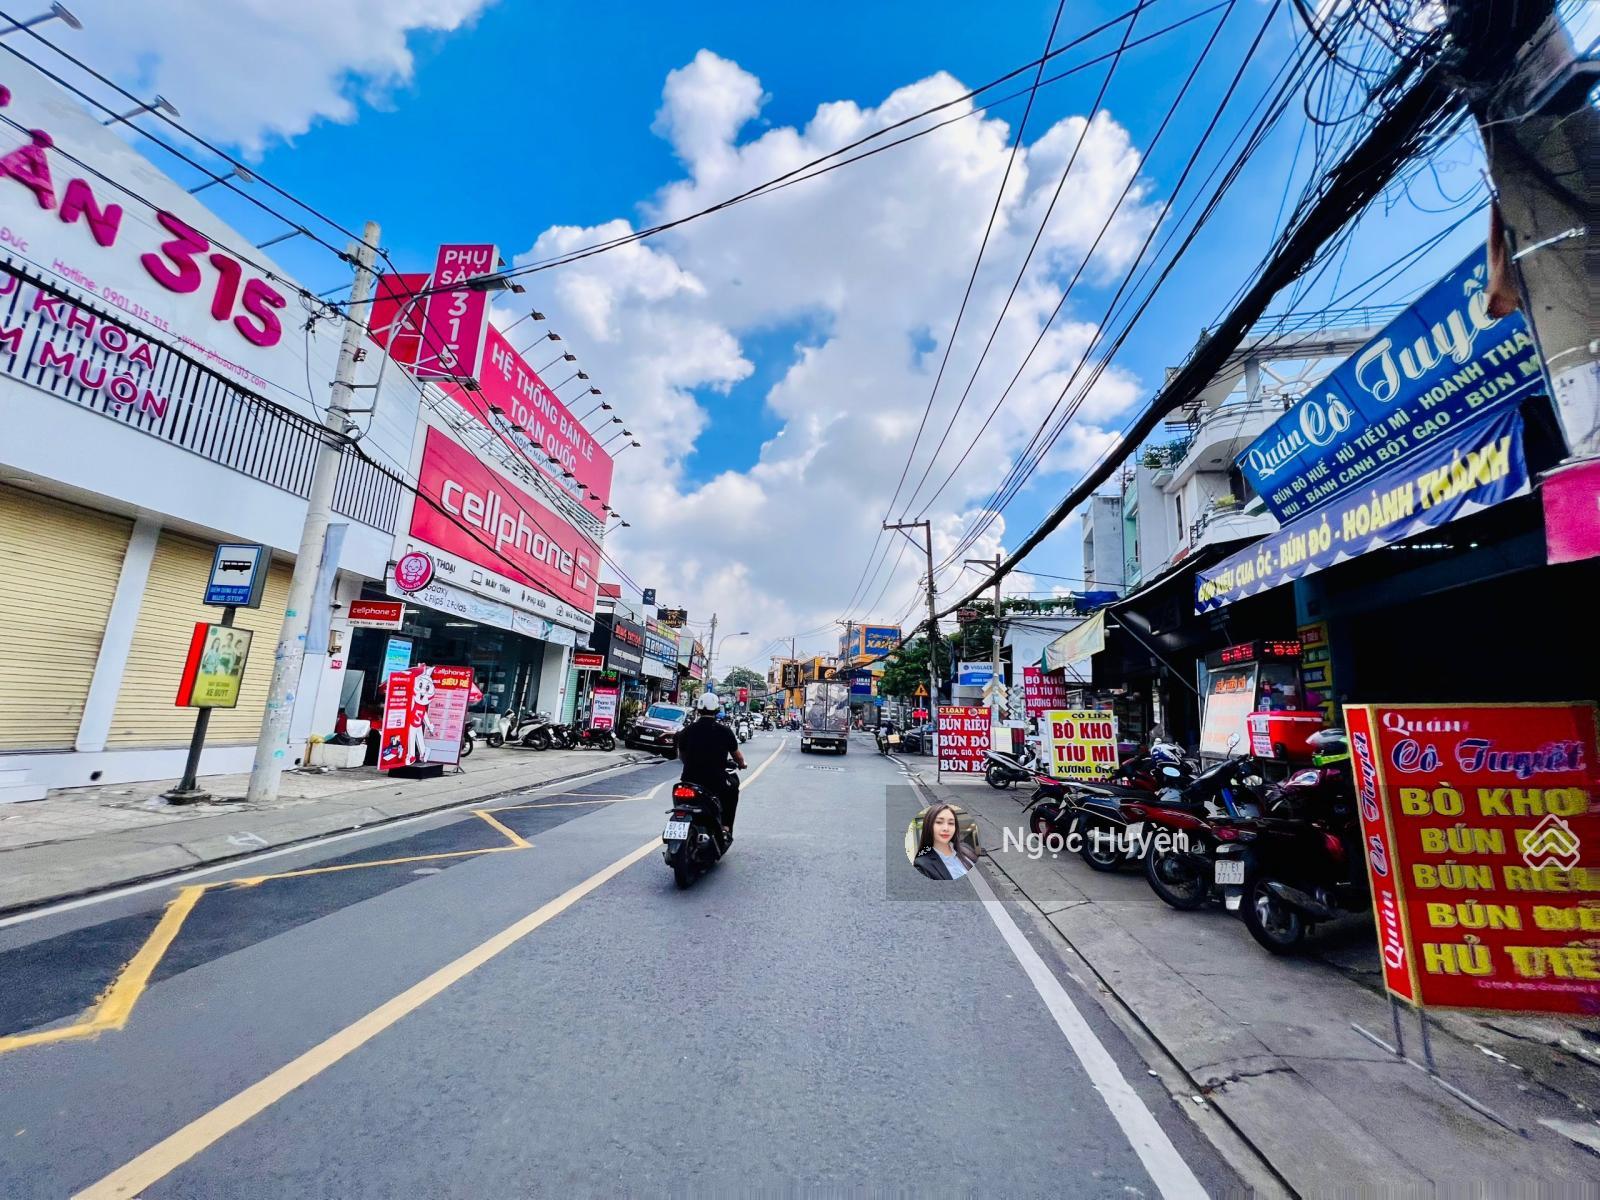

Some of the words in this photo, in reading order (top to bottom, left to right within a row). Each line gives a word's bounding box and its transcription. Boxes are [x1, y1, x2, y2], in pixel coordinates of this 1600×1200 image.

[0, 85, 123, 247] ẢN
[140, 211, 286, 347] 315
[444, 250, 488, 269] PHỤ
[33, 290, 154, 370] KHOA
[39, 341, 168, 418] MUỘN
[1245, 428, 1310, 481] Quán
[1299, 393, 1356, 448] Cô
[1355, 264, 1503, 404] Tuyế
[491, 342, 514, 382] HỆ
[516, 366, 558, 425] THỐNG
[559, 414, 582, 450] BÁN
[582, 439, 594, 462] LẺ
[1272, 485, 1292, 506] BÚN
[1293, 471, 1308, 492] BÒ
[1308, 456, 1329, 483] HUẾ
[1336, 442, 1355, 466] HỦ
[1355, 420, 1388, 455] TIẾU
[1390, 408, 1411, 433] MÌ
[1418, 362, 1485, 409] HOÀNH
[1482, 327, 1533, 367] THÁ
[510, 395, 545, 443] TOÀN
[546, 435, 577, 473] QUỐC
[1282, 500, 1301, 518] NUI
[1305, 477, 1339, 508] BÁNH
[1339, 456, 1375, 485] CANH
[1375, 433, 1411, 462] BỘT
[1413, 411, 1452, 441] GẠO
[1464, 373, 1516, 409] BÚN
[1518, 353, 1543, 378] M
[1235, 560, 1254, 589] CUA
[1256, 544, 1272, 578] ỐC
[1279, 533, 1308, 568] BÚN
[1308, 513, 1332, 559] ĐỎ
[939, 715, 962, 731] BÚN
[940, 732, 967, 747] BÚN
[1053, 720, 1075, 739] BÒ
[1079, 723, 1113, 739] KHO
[940, 757, 968, 771] BÚN
[1055, 743, 1086, 762] TÍU
[1091, 743, 1116, 762] MÌ
[1057, 765, 1092, 774] XƯƠNG
[1392, 738, 1444, 773] Cô
[1399, 781, 1465, 817] BÒ
[1476, 787, 1590, 817] KHO
[1419, 822, 1506, 855] BÚN
[1412, 859, 1496, 891] BÚN
[1426, 899, 1523, 931] BÚN
[1422, 933, 1496, 976] HỦ
